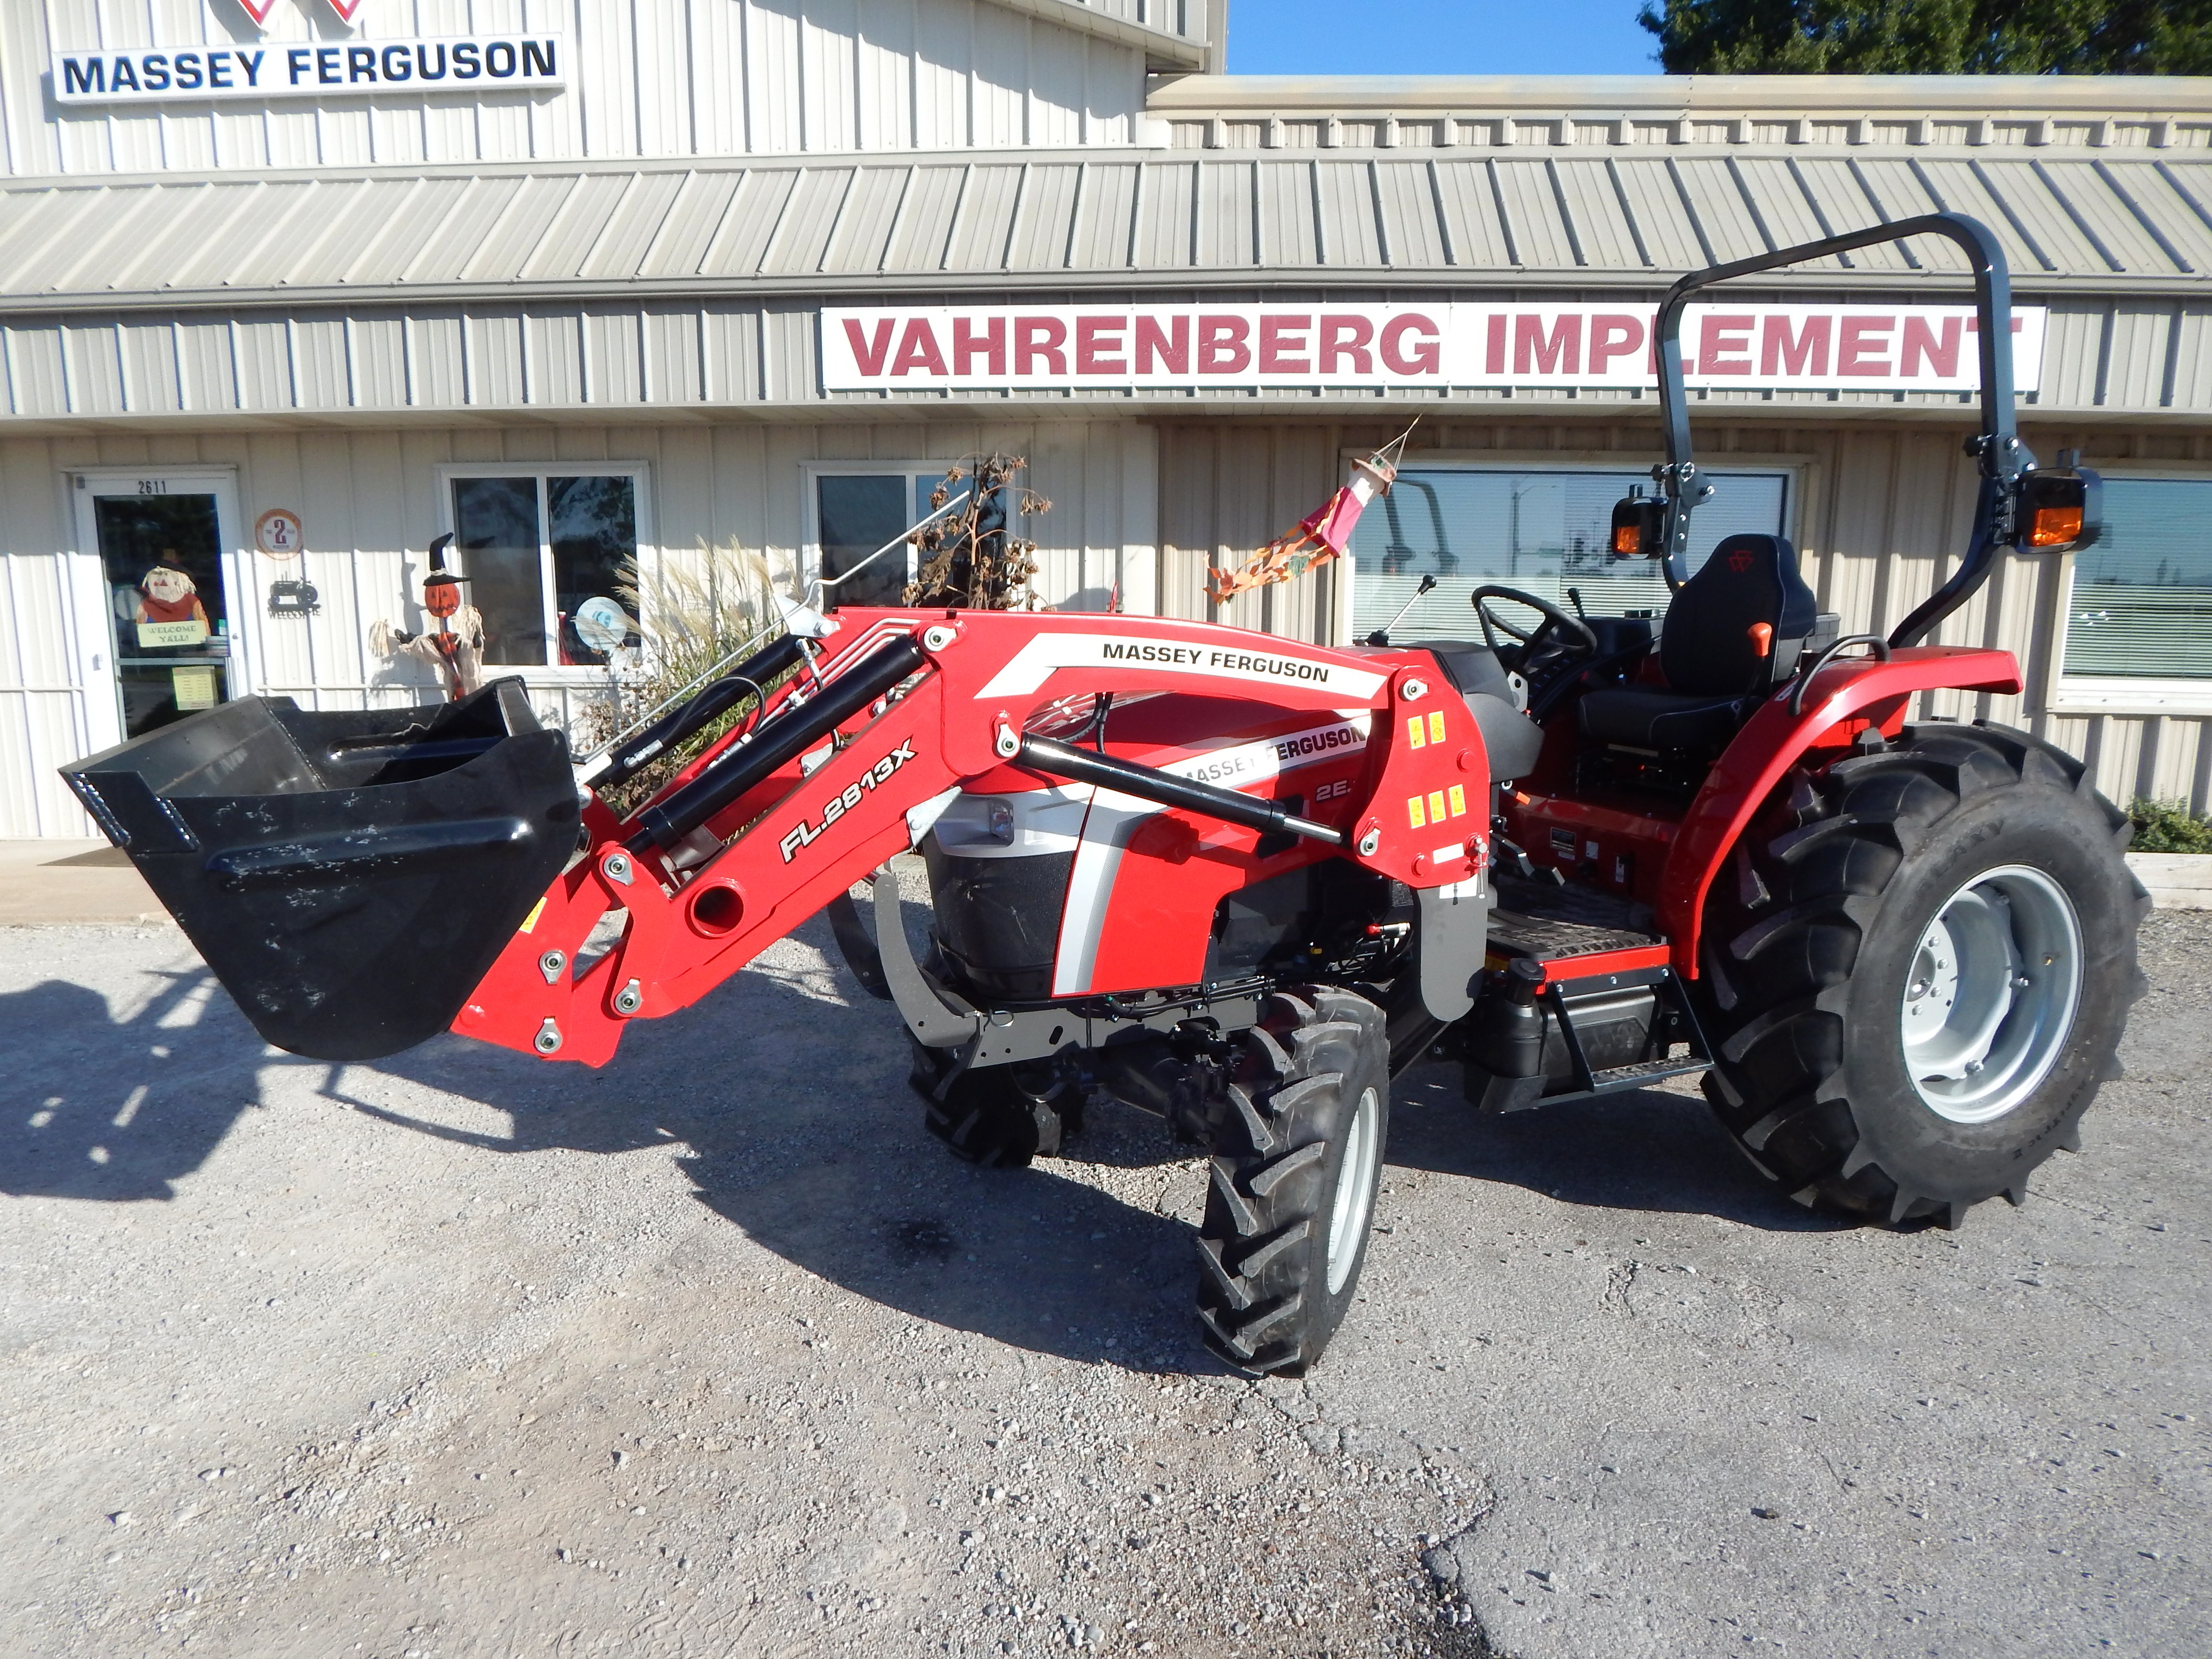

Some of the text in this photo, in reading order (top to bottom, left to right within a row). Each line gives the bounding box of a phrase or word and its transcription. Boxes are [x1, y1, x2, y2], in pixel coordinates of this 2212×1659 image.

[63, 40, 556, 94] MASSEY FERGUSON
[842, 313, 1441, 376] VAHRENBERG
[138, 480, 166, 494] 2611
[274, 519, 287, 544] 2
[148, 625, 197, 634] WELCOME
[1103, 643, 1329, 683] MASSEY FERGUSON
[1187, 757, 1254, 782] ASSE
[779, 735, 917, 864] FL.2813X
